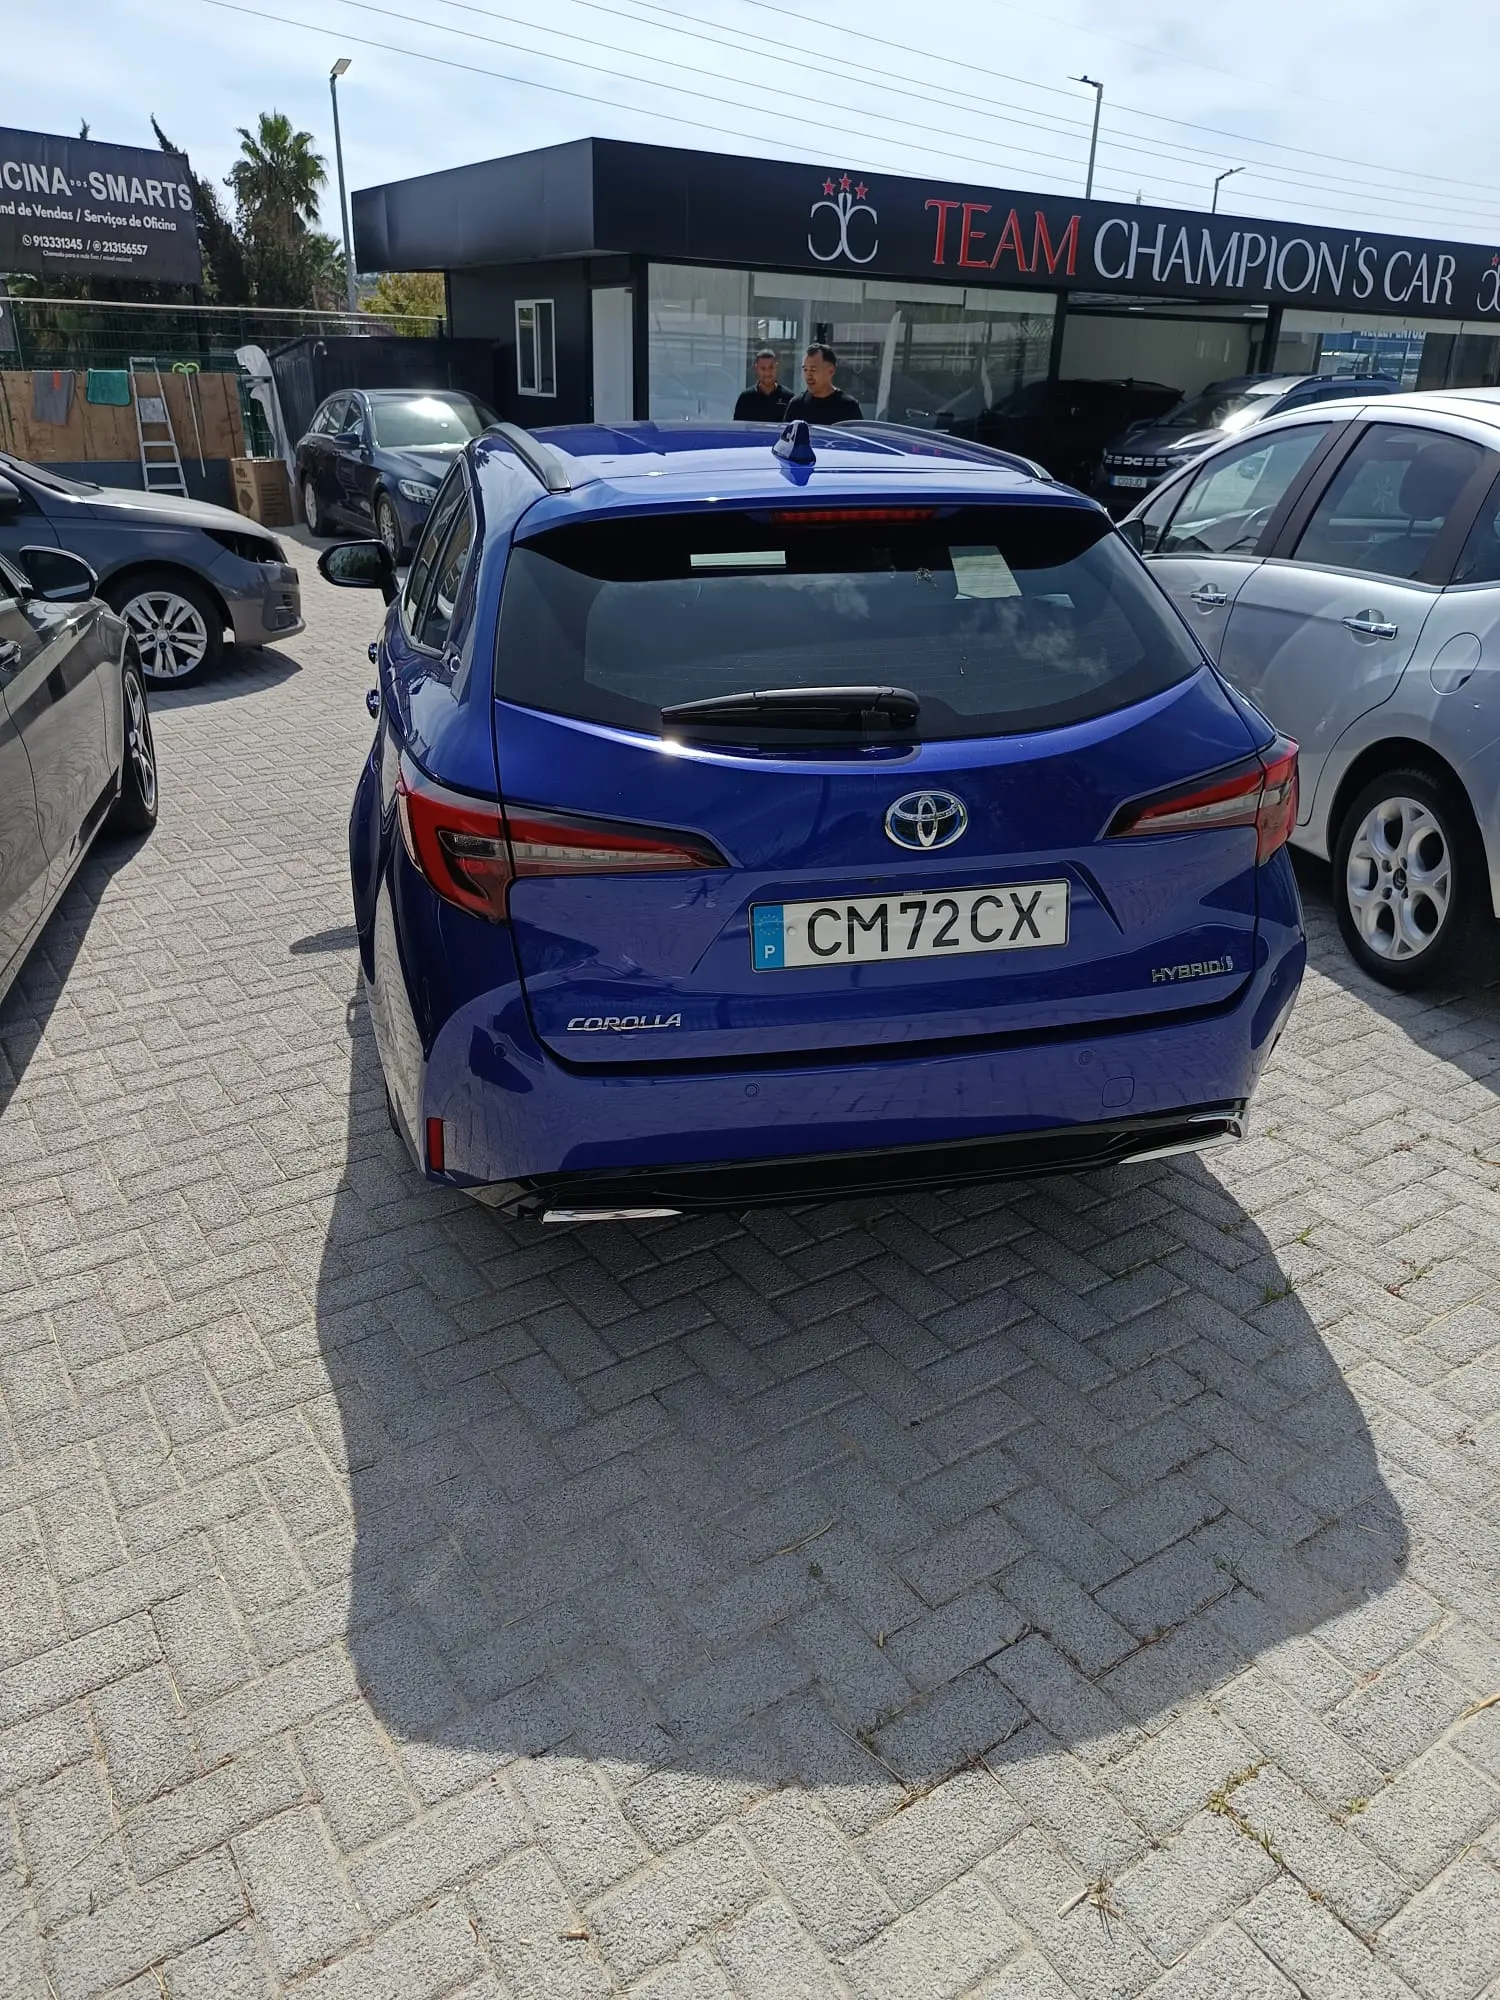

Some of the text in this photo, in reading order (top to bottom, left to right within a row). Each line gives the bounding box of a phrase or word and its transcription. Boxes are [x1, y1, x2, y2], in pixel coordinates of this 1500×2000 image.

[89, 171, 193, 211] SMARTS
[0, 201, 15, 215] nd
[18, 202, 32, 216] de
[32, 203, 73, 220] Vendas
[84, 209, 128, 229] Serviços
[129, 214, 142, 227] de
[143, 216, 177, 231] Oficina
[33, 235, 83, 250] 913331345
[102, 240, 148, 256] 213156557
[924, 199, 1081, 276] TEAM
[1094, 218, 1378, 299] CHAMPION'S
[1384, 250, 1456, 305] CAR
[764, 945, 775, 959] P
[1152, 960, 1223, 983] HYBRID
[567, 1013, 681, 1032] COROLLA
